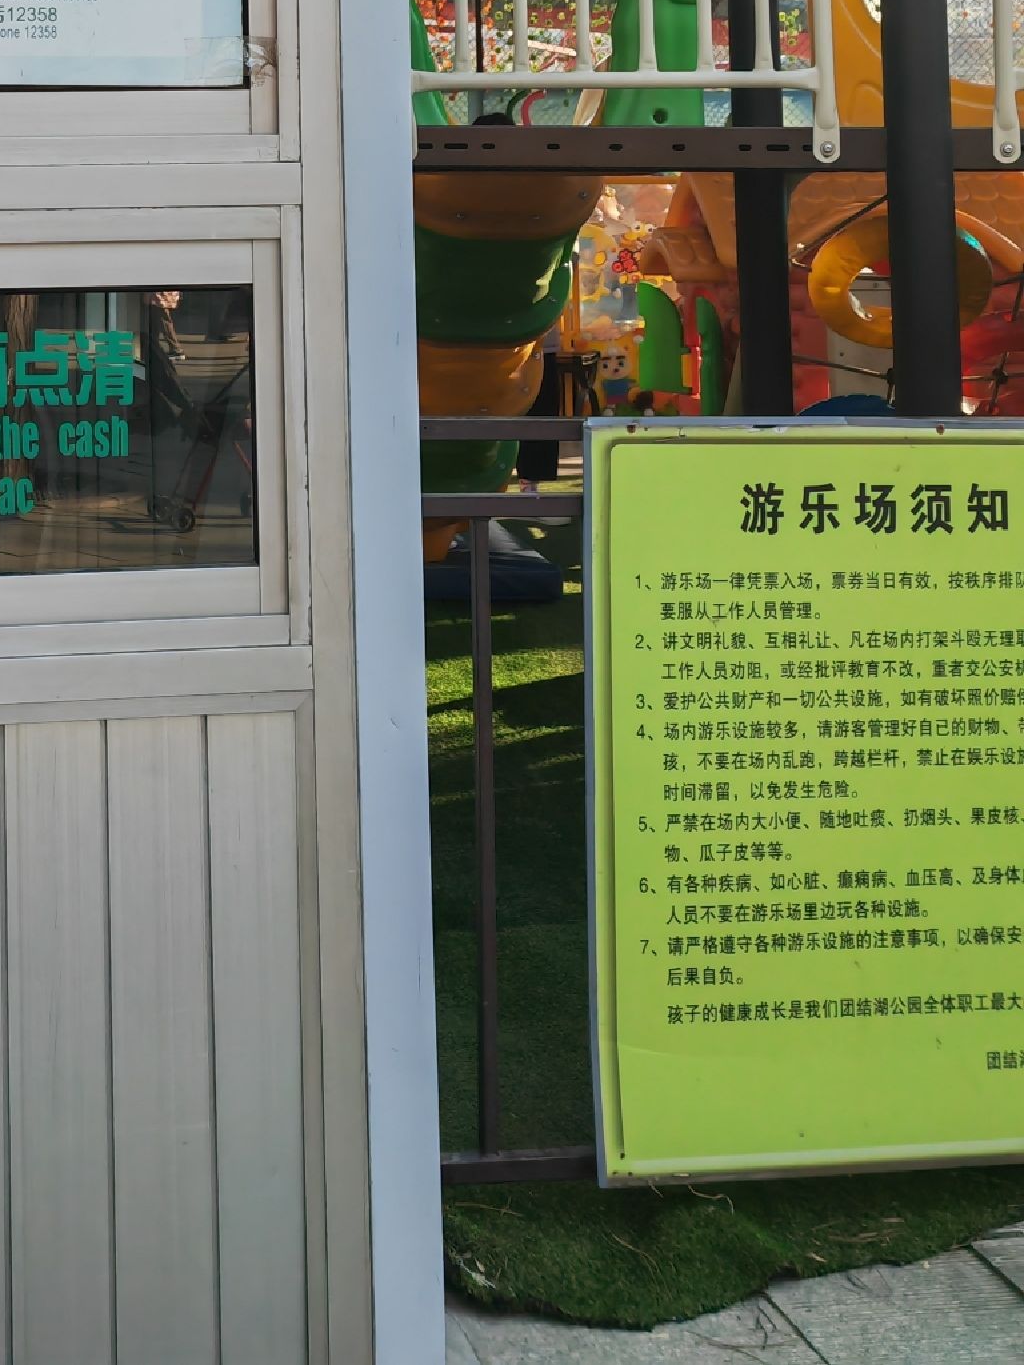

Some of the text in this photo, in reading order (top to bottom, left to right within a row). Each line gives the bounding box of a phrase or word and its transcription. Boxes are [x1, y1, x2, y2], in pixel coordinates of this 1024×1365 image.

[24, 27, 58, 40] 12358
[59, 415, 129, 458] cash
[740, 482, 1008, 536] 游乐场须知
[660, 600, 821, 620] 要服从工作人员管理。
[667, 966, 743, 986] 后果自负。
